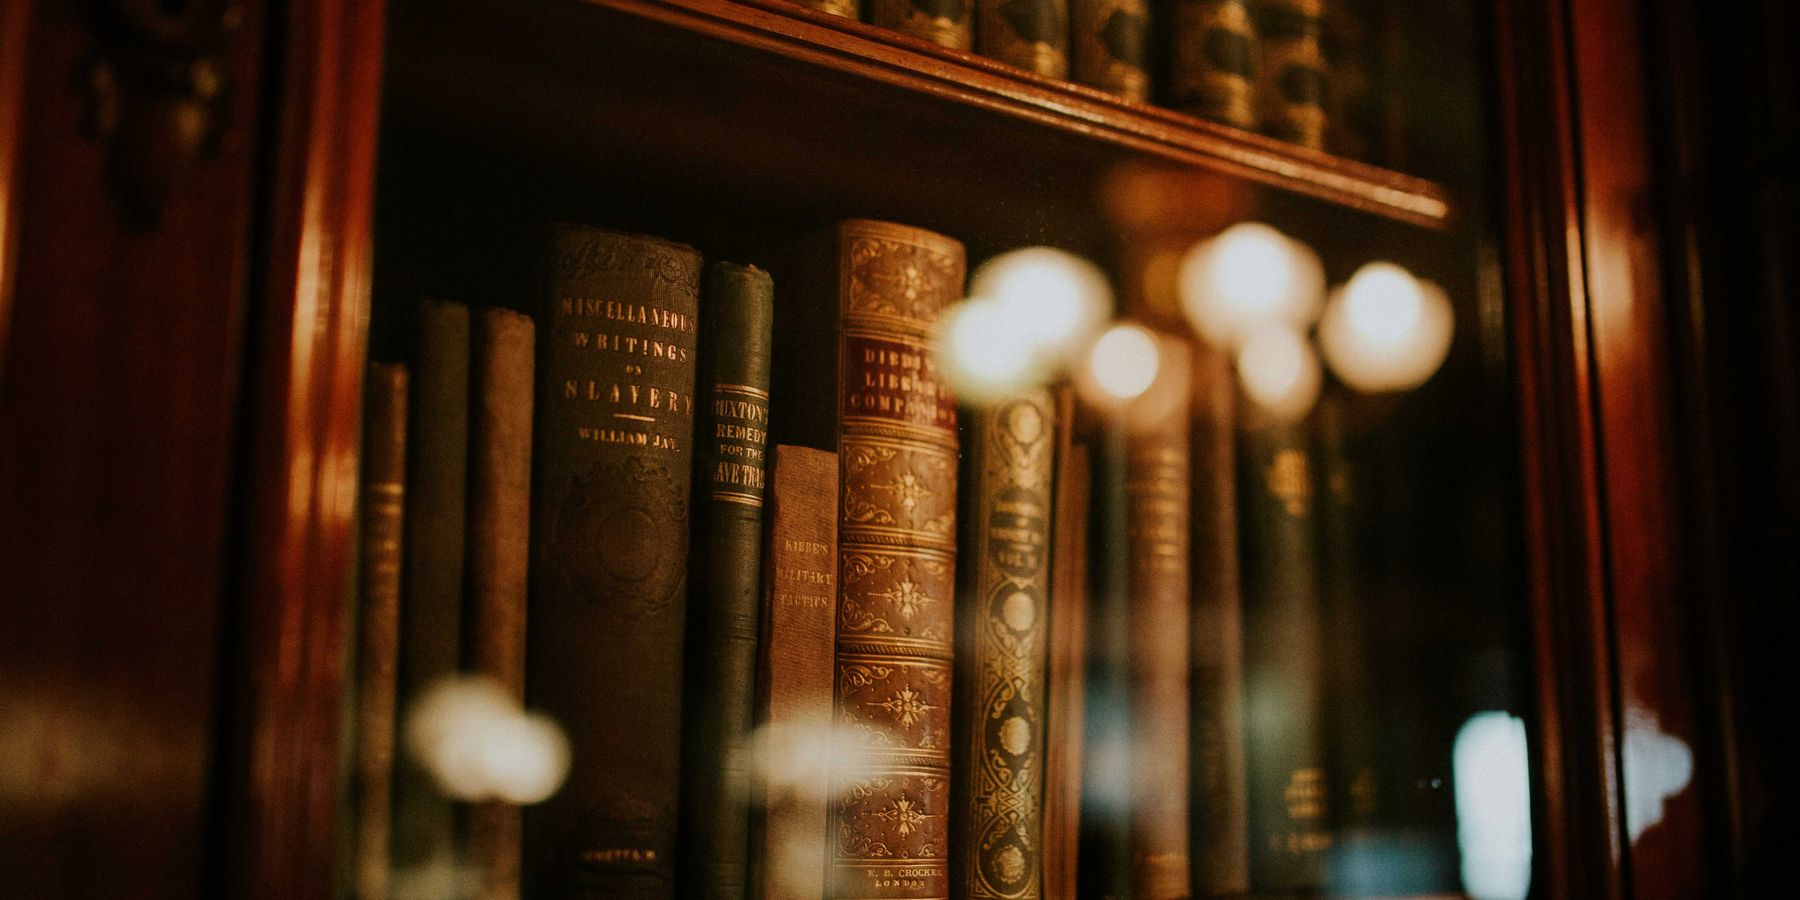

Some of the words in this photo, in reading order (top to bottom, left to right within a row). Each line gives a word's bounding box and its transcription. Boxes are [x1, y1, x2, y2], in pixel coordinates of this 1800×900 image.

[562, 297, 695, 335] MISCELLANEOUS
[575, 331, 688, 364] WRITINGS
[564, 379, 692, 417] SLAVERY
[578, 427, 648, 447] WILLIAM
[716, 422, 768, 445] REMEDY
[720, 443, 743, 457] FOR
[746, 446, 763, 461] THE
[867, 868, 879, 878] E.
[883, 868, 894, 878] B.
[874, 879, 926, 889] LONDON
